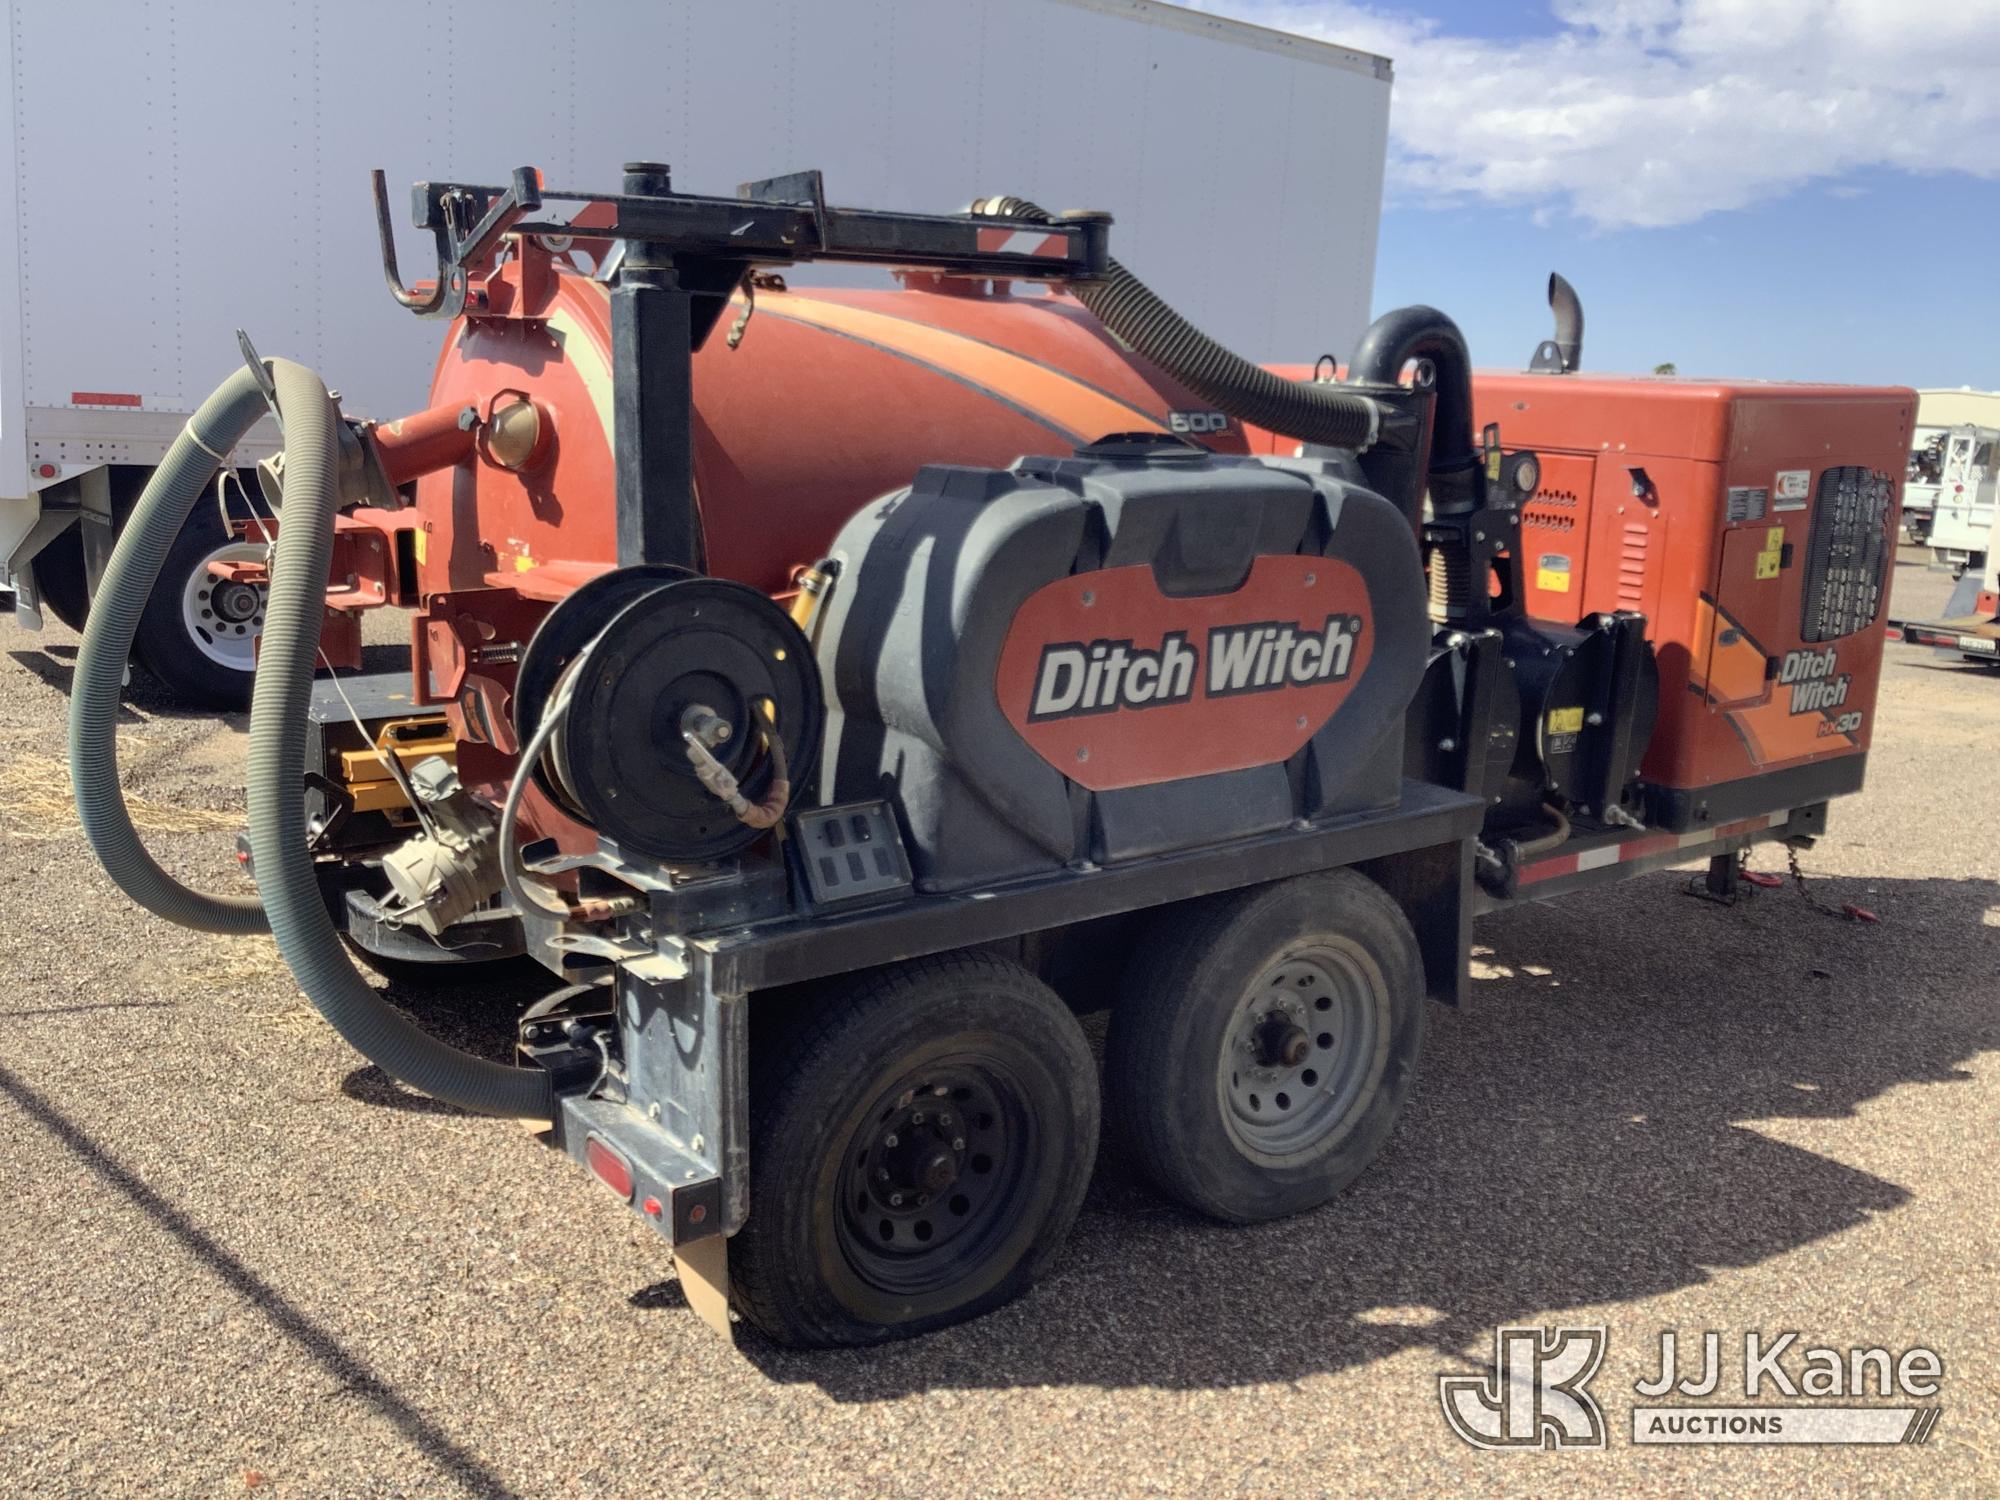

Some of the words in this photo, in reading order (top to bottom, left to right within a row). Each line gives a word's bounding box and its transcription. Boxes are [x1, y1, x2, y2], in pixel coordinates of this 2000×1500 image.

[1169, 412, 1227, 433] 500
[1033, 636, 1197, 716] Ditch
[1780, 647, 1837, 683] Ditch
[1791, 676, 1849, 714] Witch
[1817, 711, 1863, 737] HX30
